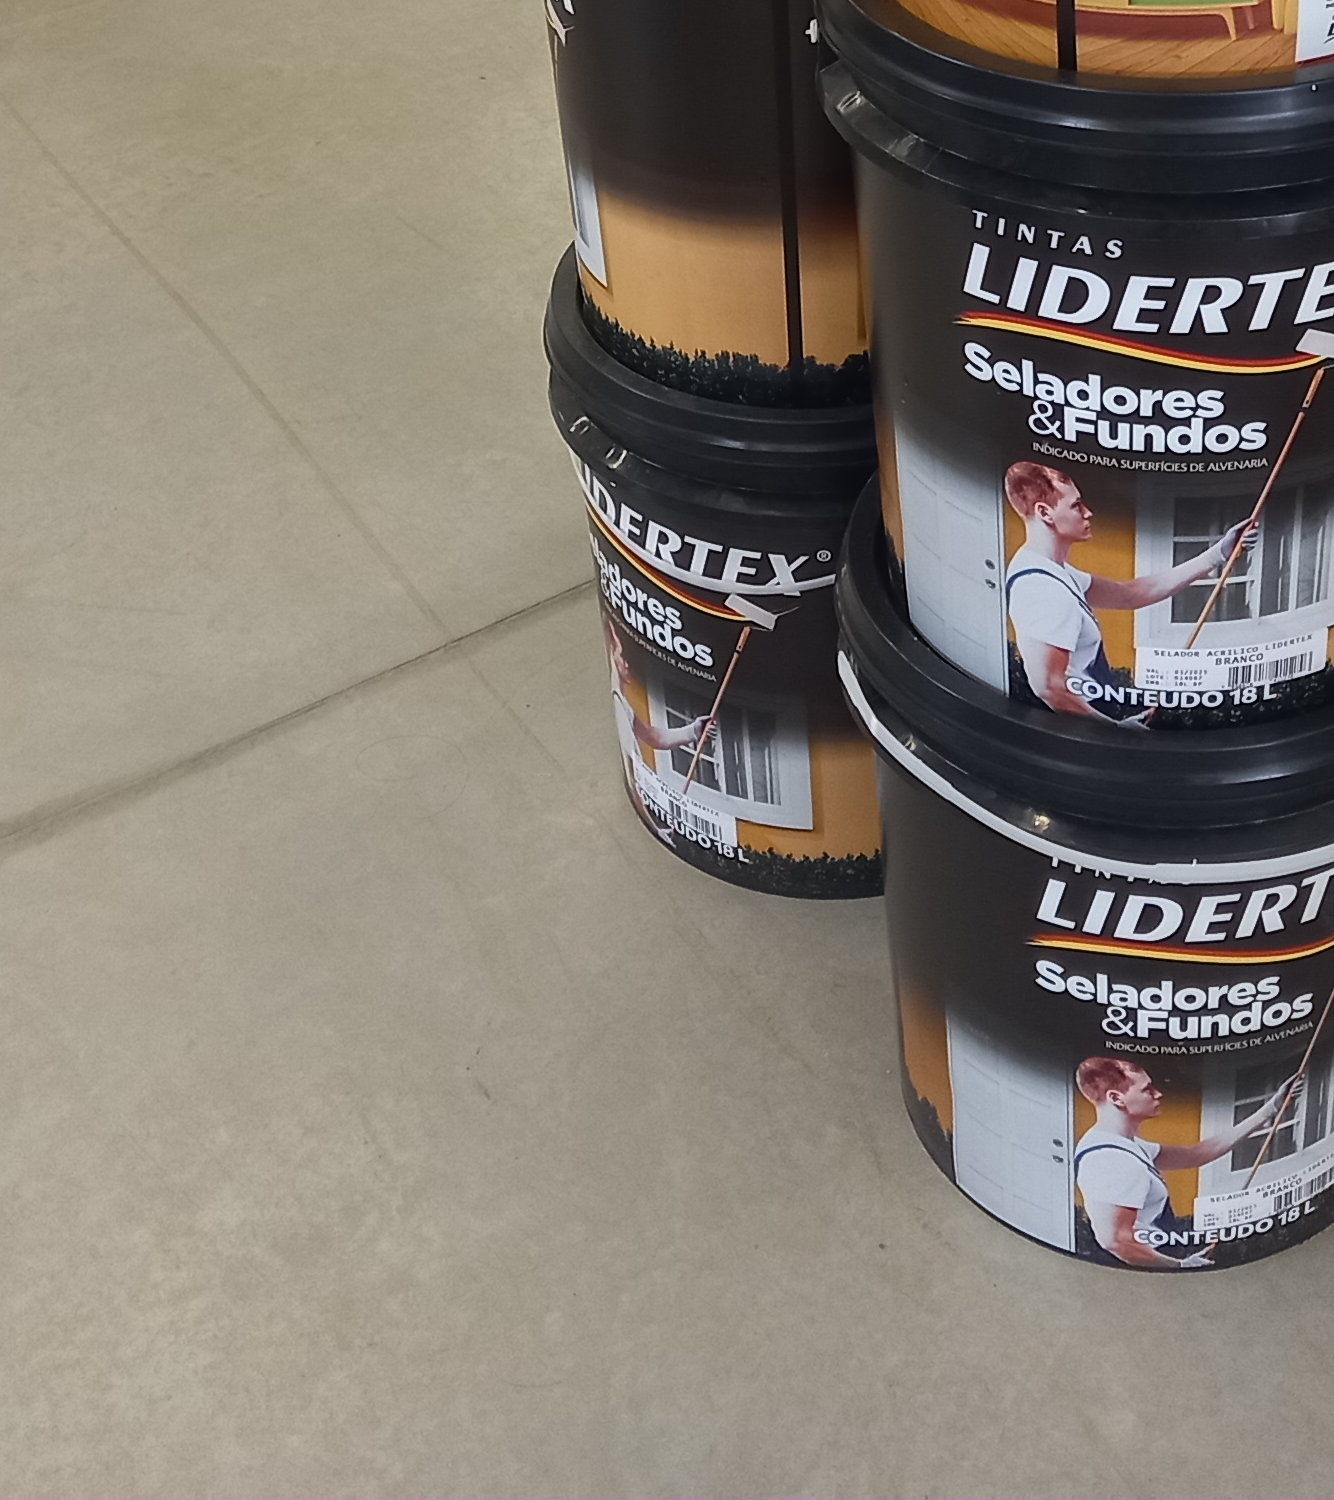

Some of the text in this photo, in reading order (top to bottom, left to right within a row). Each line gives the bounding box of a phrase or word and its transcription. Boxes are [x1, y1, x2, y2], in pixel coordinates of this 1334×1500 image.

[971, 209, 1124, 260] TINTAS
[963, 342, 1226, 420] Seladores
[1033, 442, 1268, 472] INDICADO PARA SUPERFÍCIES DE ALVENARIA
[1154, 634, 1313, 658] SELADOR ACRILICO LIDERTEX
[1215, 653, 1264, 666] BRANCO
[1229, 686, 1258, 706] 18
[1263, 684, 1277, 701] L
[714, 841, 734, 858] 18
[737, 848, 749, 863] L
[1034, 959, 1280, 1013] Seladores
[1105, 1040, 1159, 1054] INDICADO
[1249, 1038, 1262, 1047] DE
[1264, 1021, 1313, 1043] ALVENARIA
[1279, 1207, 1300, 1226] 18
[1304, 1200, 1316, 1215] L
